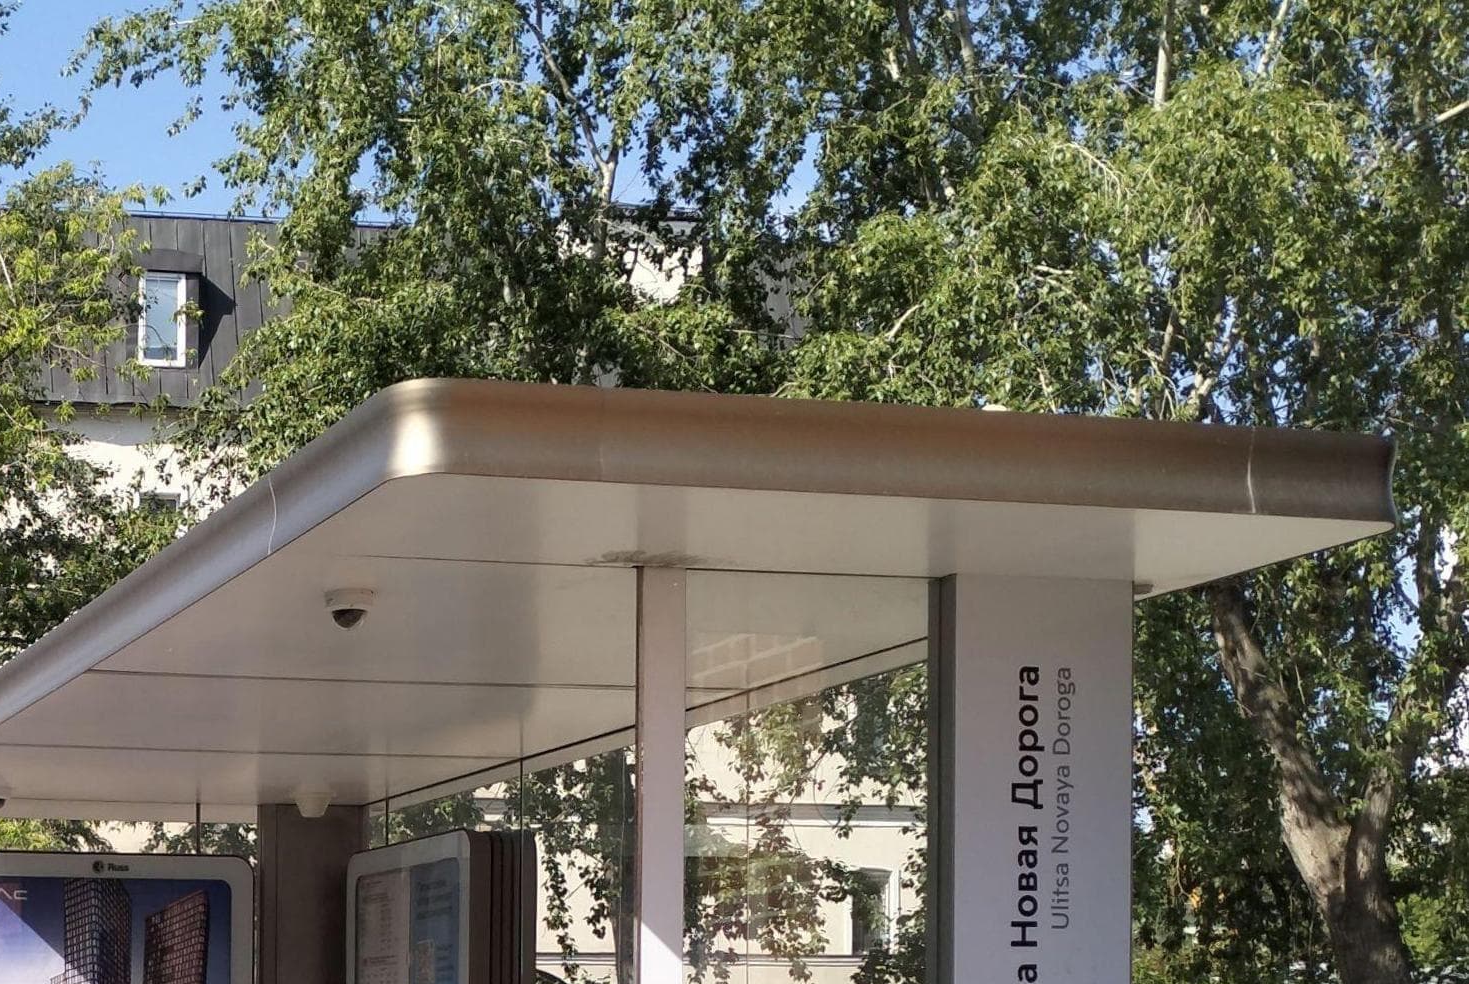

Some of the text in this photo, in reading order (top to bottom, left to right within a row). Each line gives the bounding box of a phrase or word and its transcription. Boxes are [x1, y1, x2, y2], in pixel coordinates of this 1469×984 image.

[1011, 665, 1046, 809] Дорога
[1051, 667, 1076, 930] Ulitsa Novaya Doroga
[1010, 826, 1039, 947] Новая
